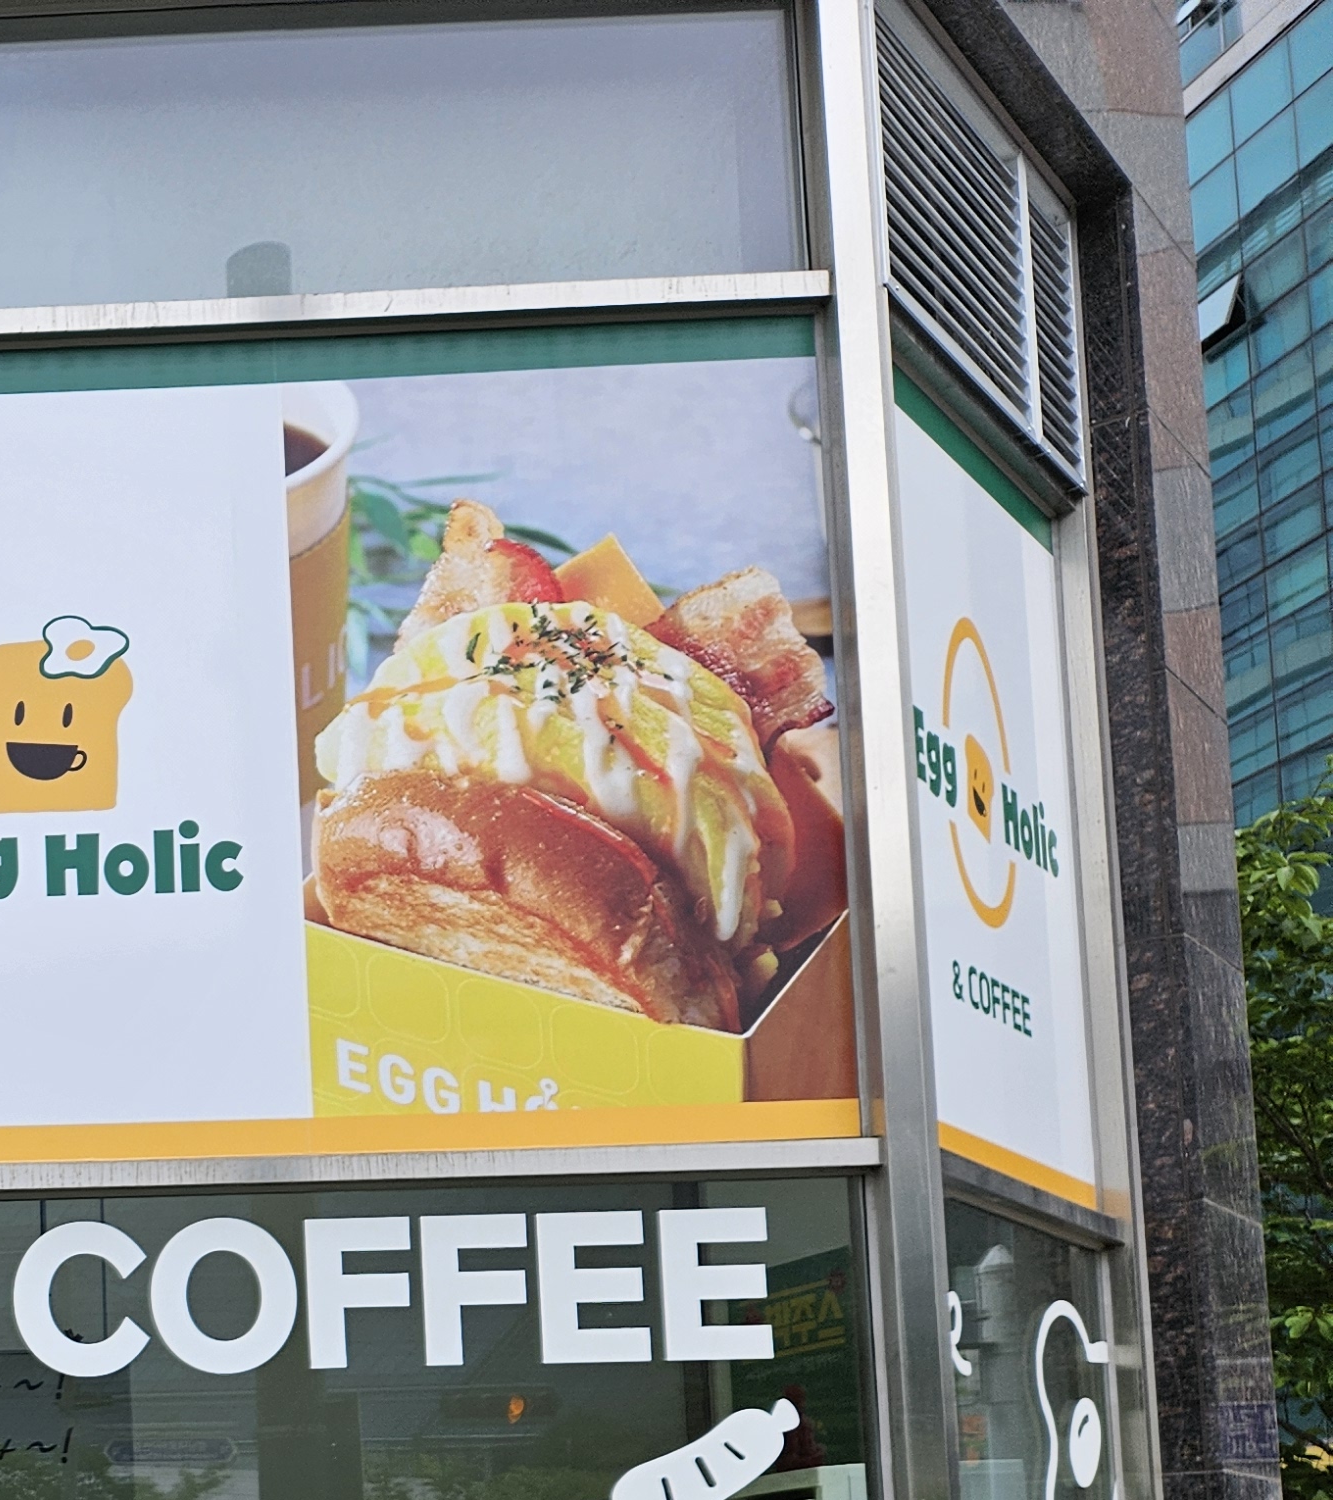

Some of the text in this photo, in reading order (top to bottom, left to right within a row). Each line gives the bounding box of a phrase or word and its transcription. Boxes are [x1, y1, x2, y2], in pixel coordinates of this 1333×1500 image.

[913, 705, 1059, 878] Egg Holic
[45, 820, 244, 897] Holic
[953, 960, 1032, 1037] & COFFEE
[336, 1038, 460, 1114] EGG
[13, 1207, 774, 1377] COFFEE
